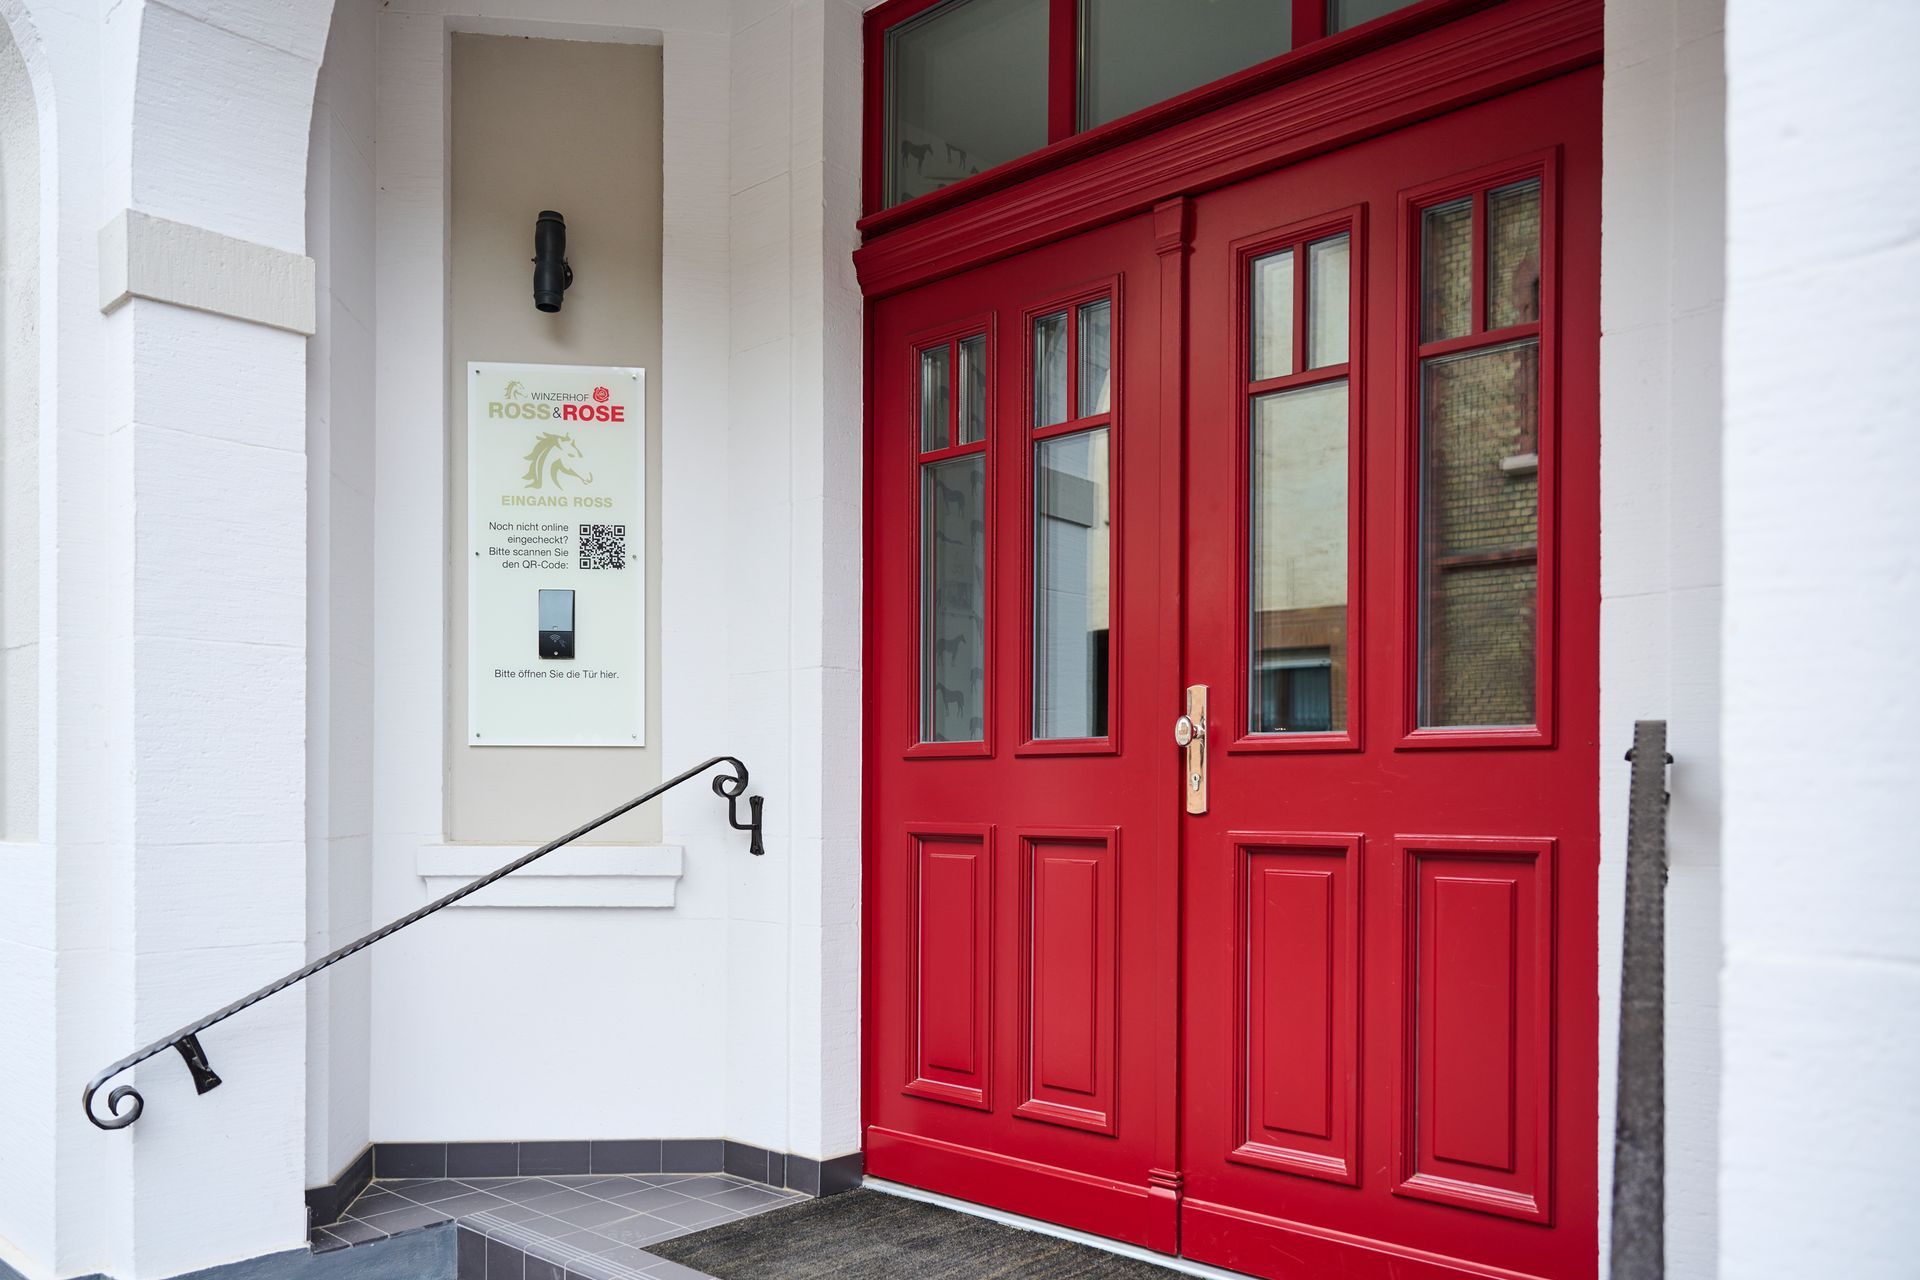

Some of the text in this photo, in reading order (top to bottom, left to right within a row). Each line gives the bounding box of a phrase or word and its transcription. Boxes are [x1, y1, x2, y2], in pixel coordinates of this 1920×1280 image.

[531, 392, 589, 402] WINZERHOF
[501, 495, 613, 508] EINGANG ROSS
[489, 522, 569, 532] Noch nicht online
[507, 535, 569, 545] eingecheckt?
[489, 547, 569, 557] Bitte scannen Sie
[502, 560, 569, 570] den QR-Code:
[494, 669, 620, 680] Bitte öffnen Sie die Tür hier.
